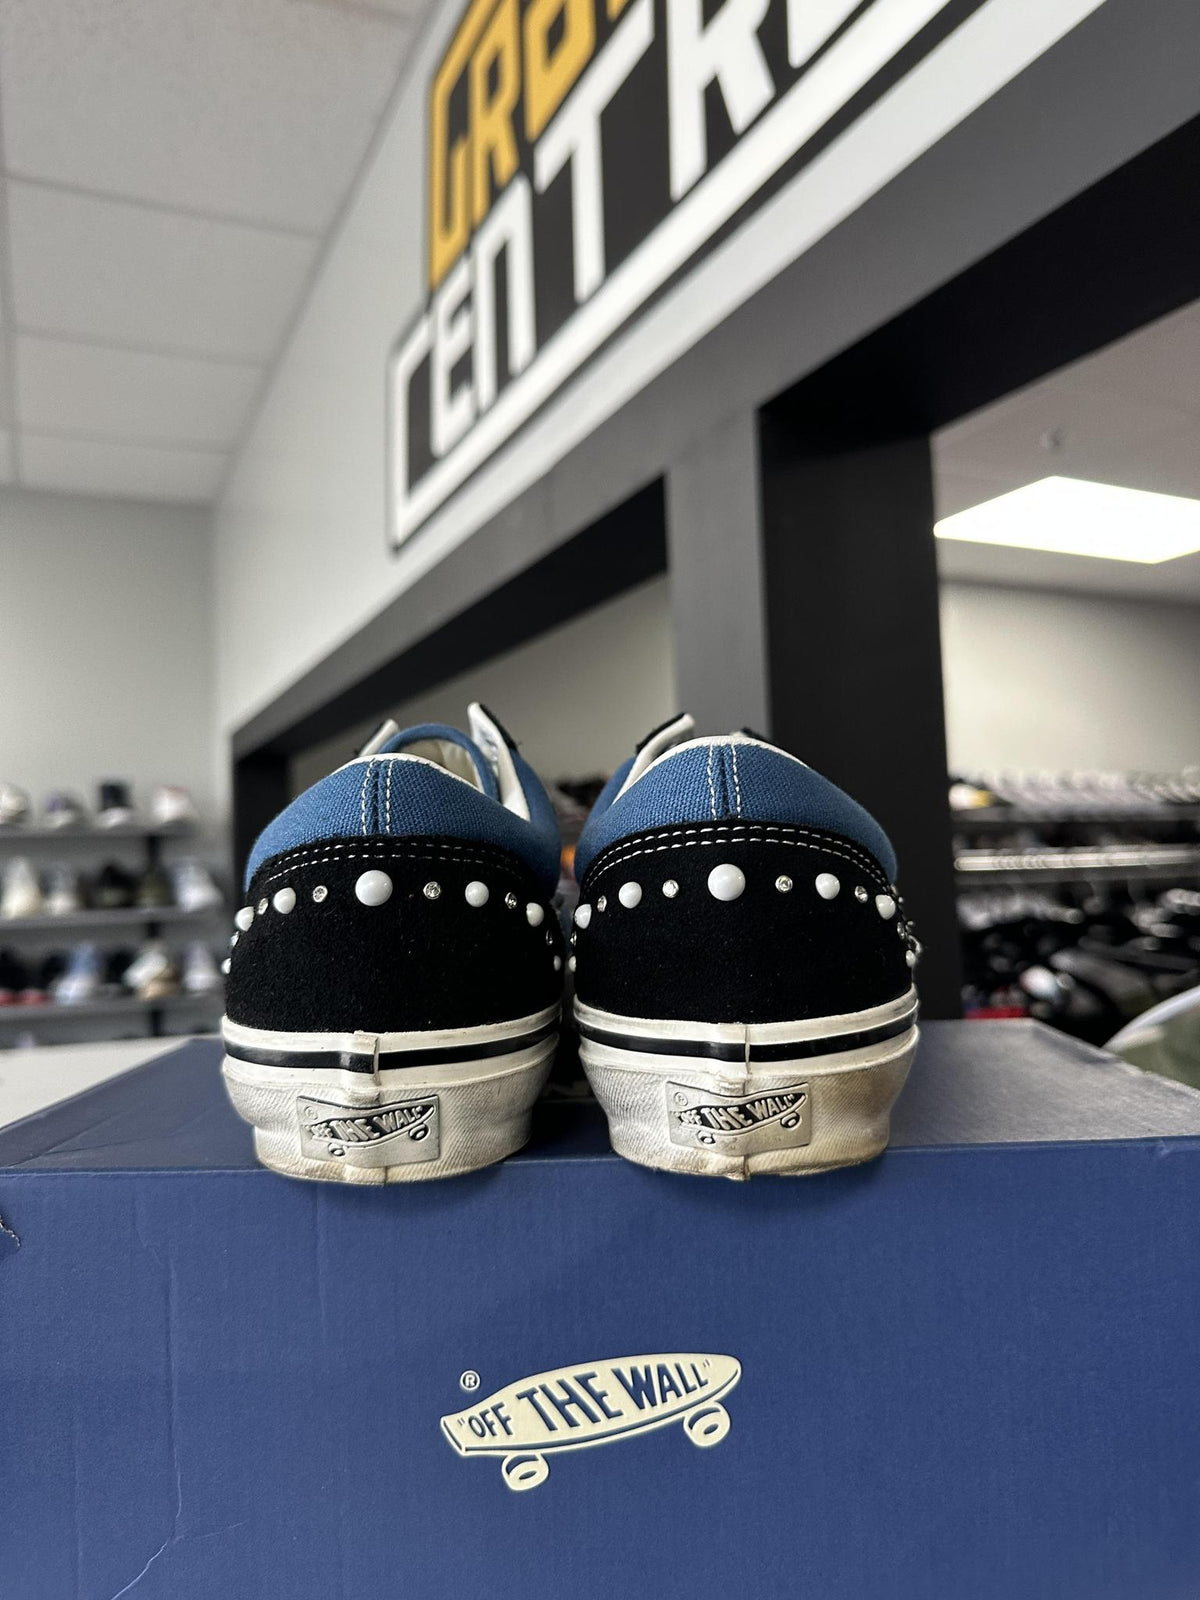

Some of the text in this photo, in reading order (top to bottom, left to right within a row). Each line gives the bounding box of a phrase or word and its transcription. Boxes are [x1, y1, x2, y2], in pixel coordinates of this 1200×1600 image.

[329, 1118, 381, 1142] THE
[701, 1106, 753, 1130] THE
[457, 1358, 711, 1439] "OFF THE WALL"
